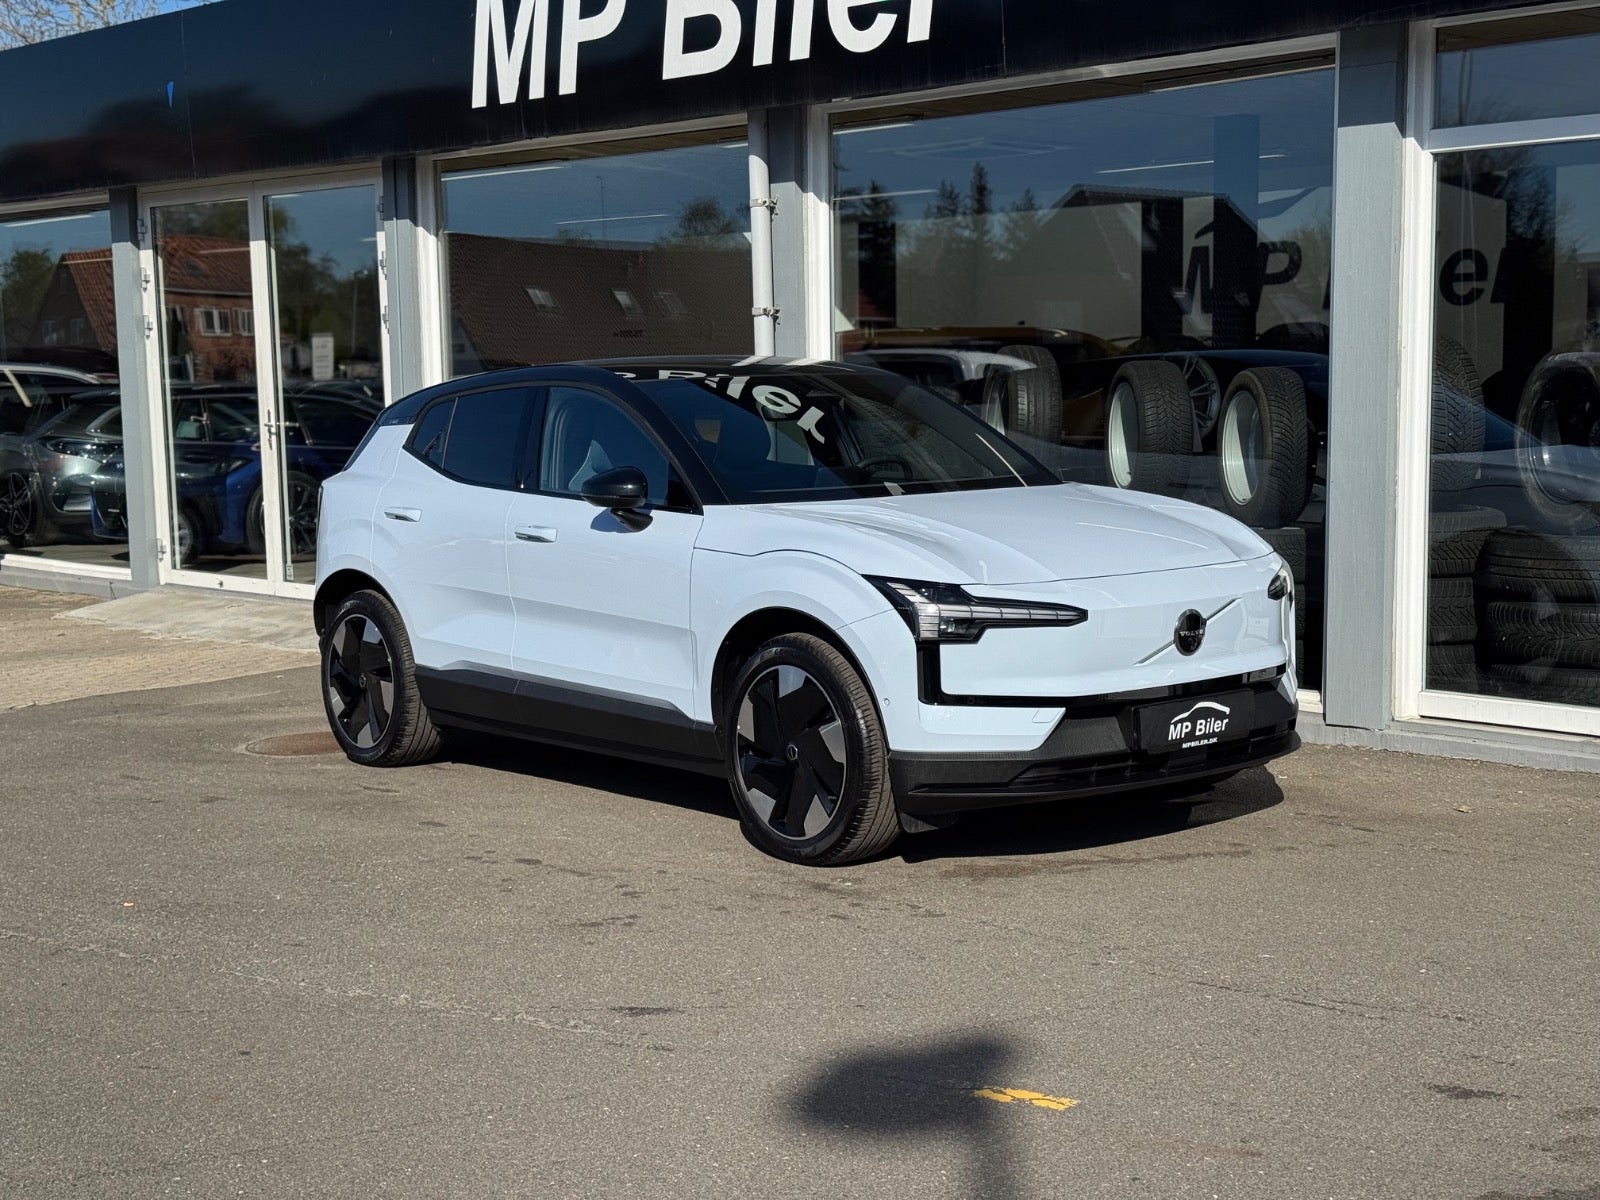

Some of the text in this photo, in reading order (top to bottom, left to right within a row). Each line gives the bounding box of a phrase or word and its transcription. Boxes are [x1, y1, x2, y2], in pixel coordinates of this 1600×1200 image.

[471, 0, 625, 109] MP
[1179, 629, 1204, 637] VOLVO
[1168, 717, 1229, 741] MP Biler
[1182, 737, 1218, 749] MPBILER.DK
